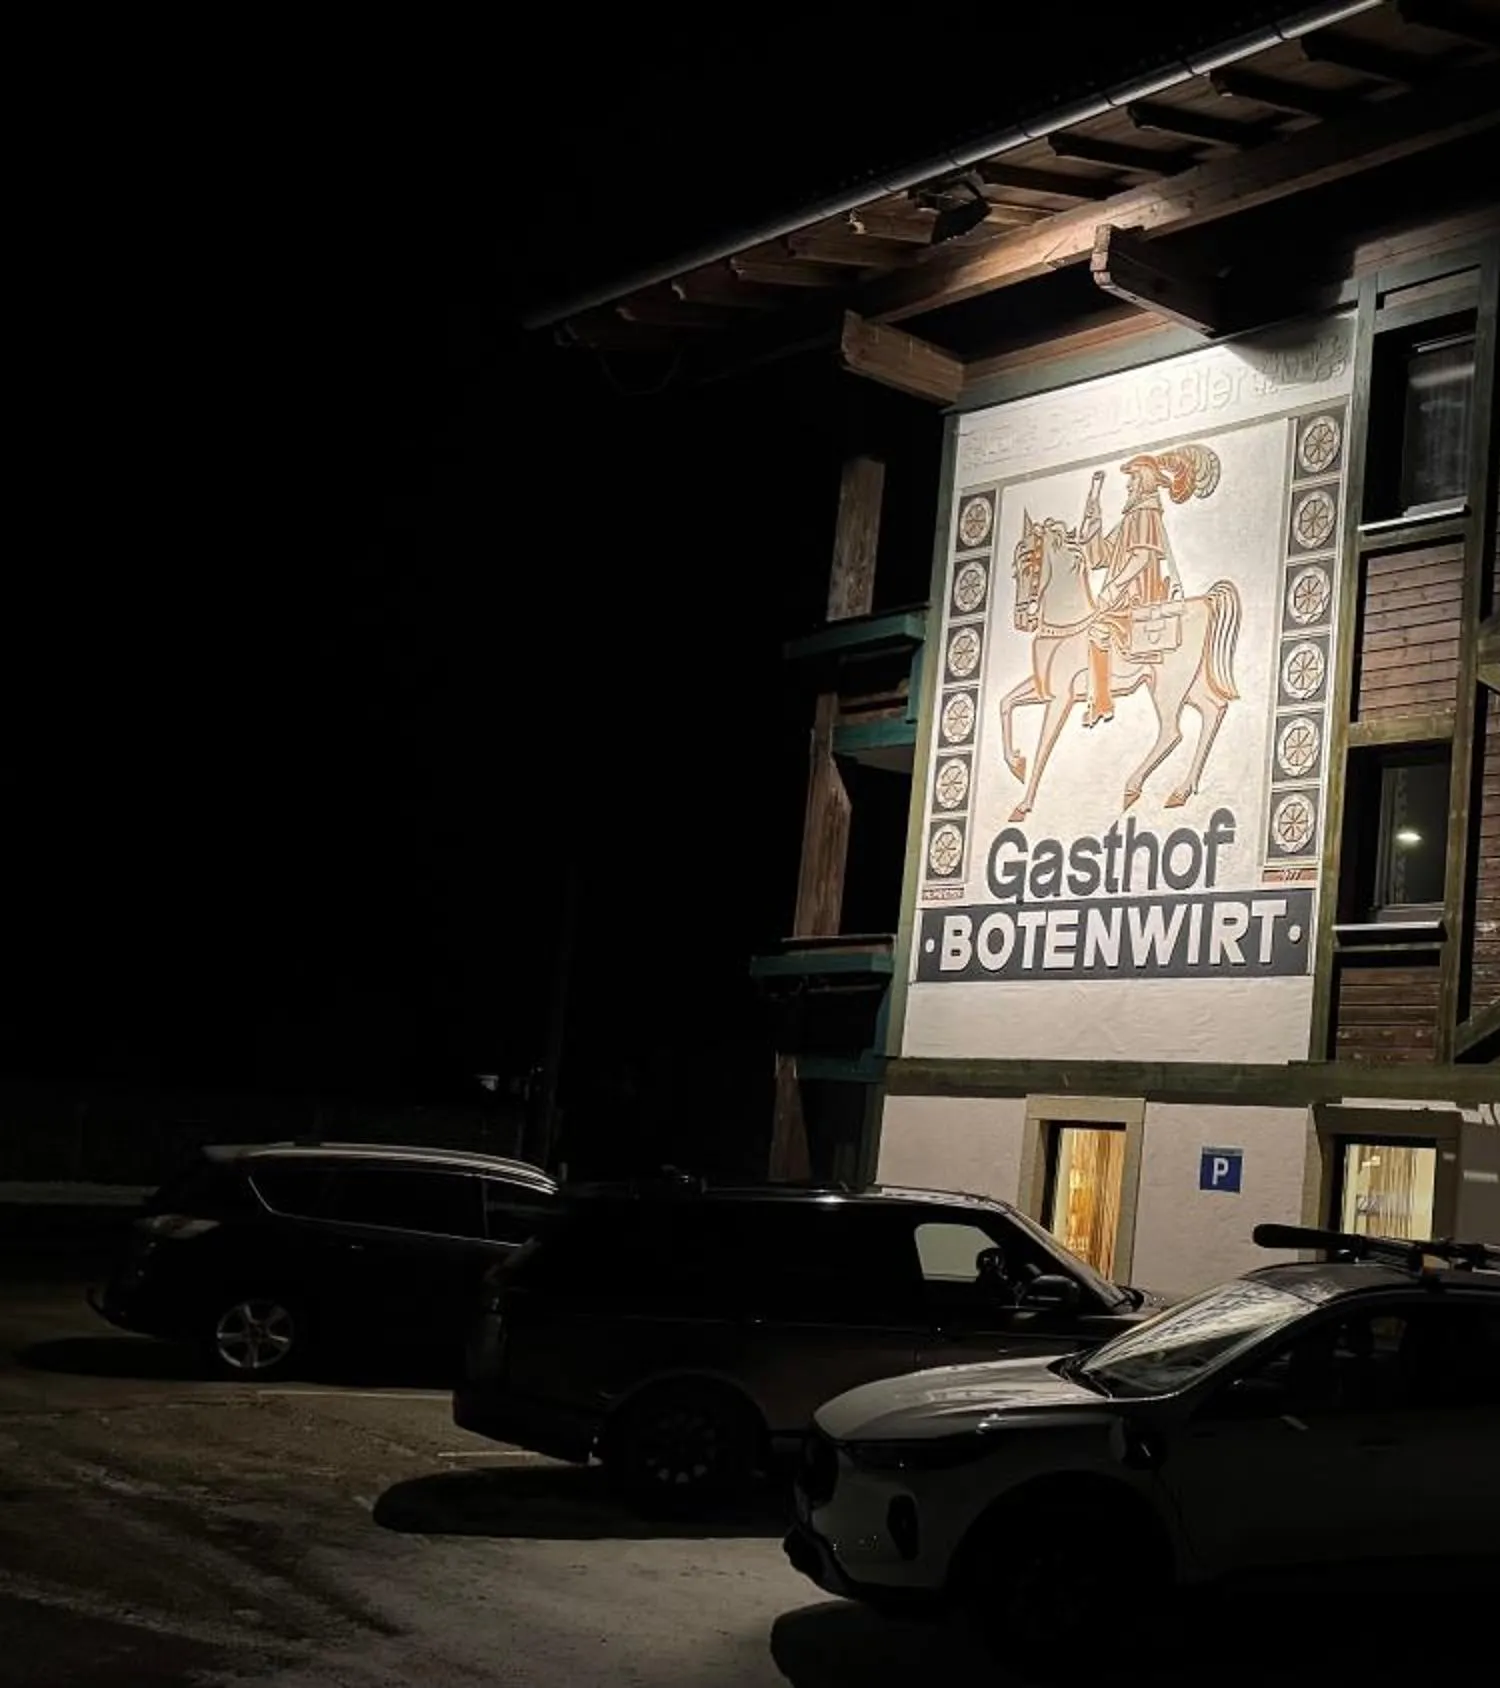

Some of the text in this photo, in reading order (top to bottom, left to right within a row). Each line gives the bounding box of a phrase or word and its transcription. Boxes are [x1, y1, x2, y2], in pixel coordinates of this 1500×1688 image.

[987, 808, 1236, 904] Gasthof
[939, 899, 1288, 972] BOTENWIRT
[1212, 1157, 1229, 1185] P
